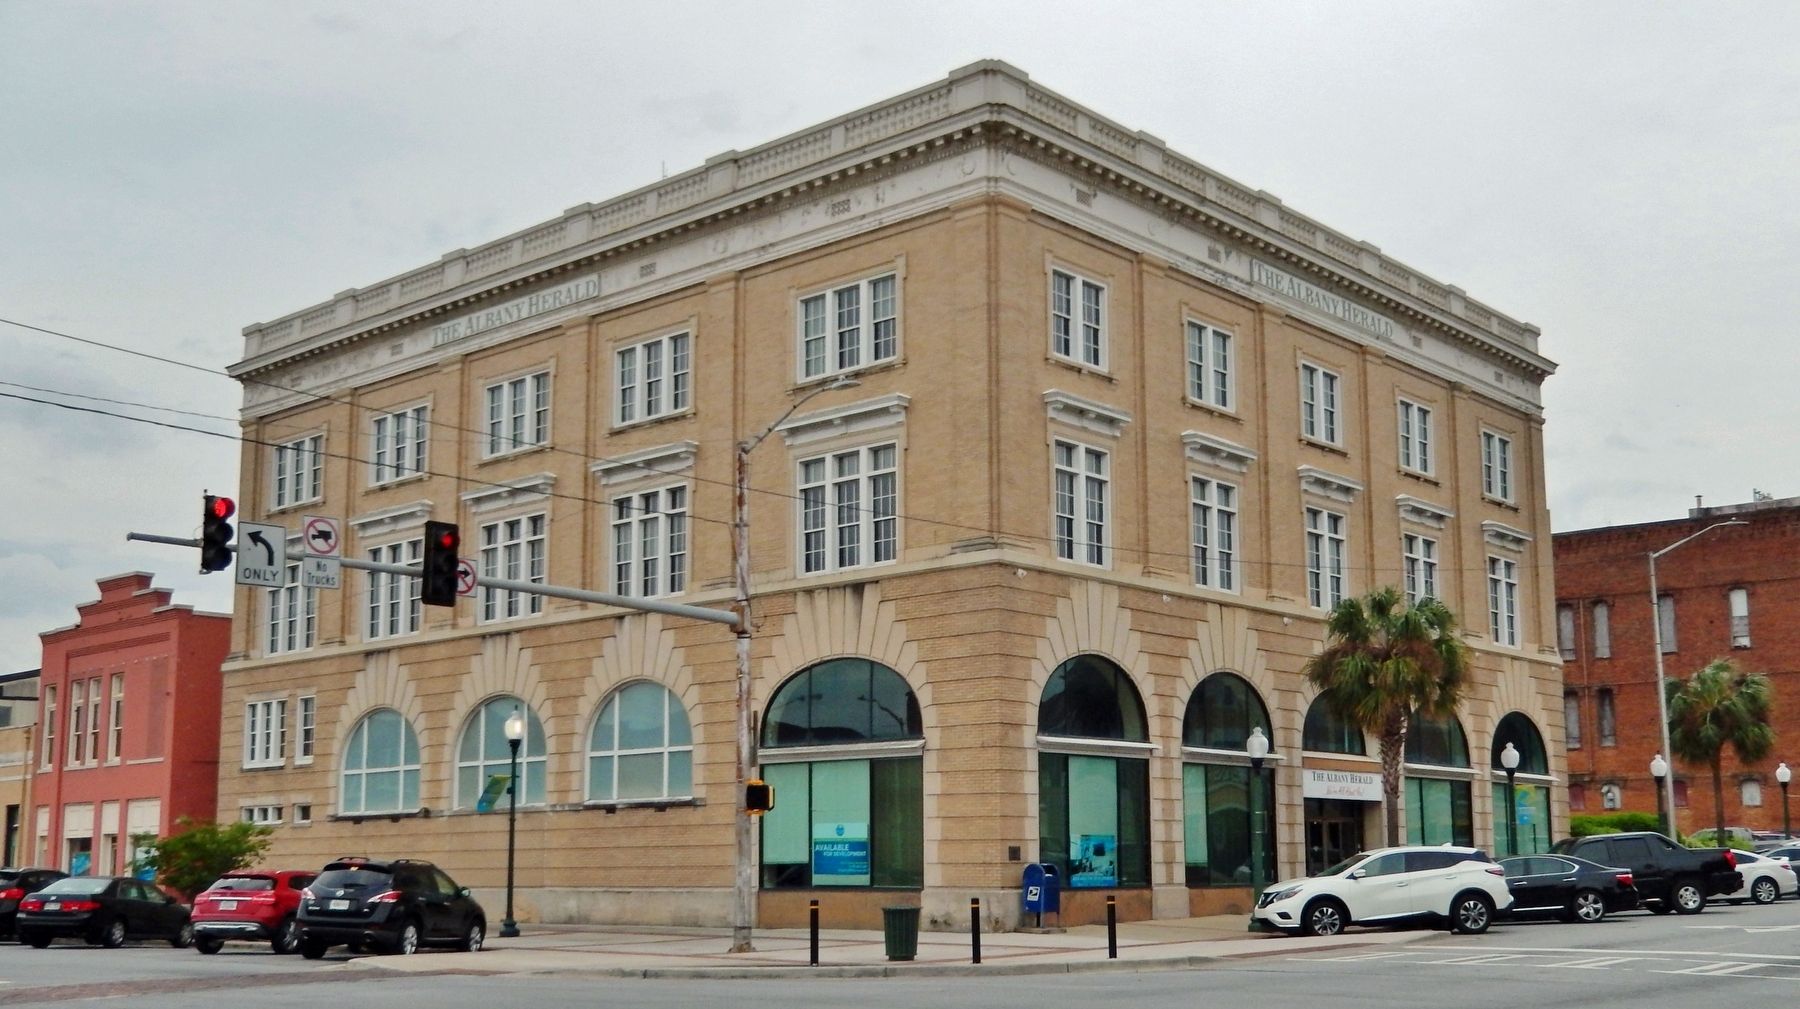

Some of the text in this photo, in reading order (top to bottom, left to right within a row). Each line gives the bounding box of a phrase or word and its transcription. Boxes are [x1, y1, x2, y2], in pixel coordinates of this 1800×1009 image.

[432, 280, 597, 346] THE ALBANY HERALD
[1255, 263, 1393, 338] THE ALBANY HERALD
[243, 568, 279, 581] ONLY
[1312, 771, 1373, 785] THE ALBANY HERALD
